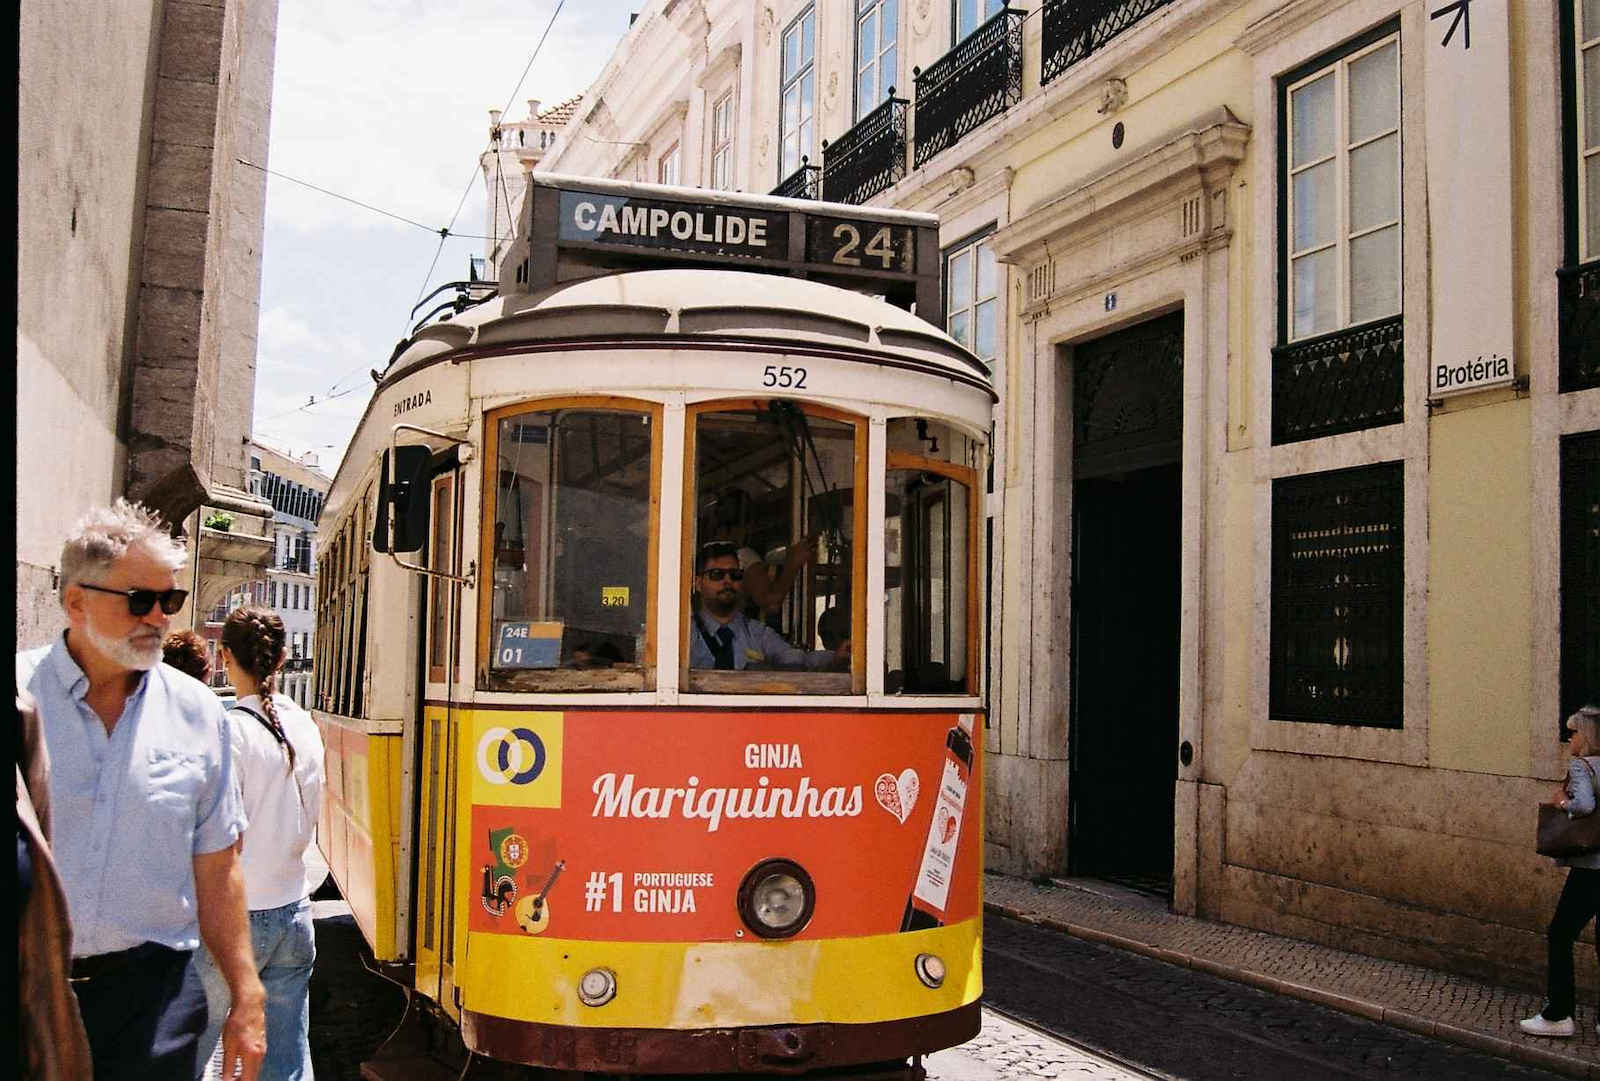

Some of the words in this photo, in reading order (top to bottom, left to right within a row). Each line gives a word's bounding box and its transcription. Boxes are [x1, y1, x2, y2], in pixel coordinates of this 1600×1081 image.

[574, 202, 767, 247] CAMPOLIDE
[832, 223, 895, 269] 24
[763, 366, 807, 389] 552
[1437, 354, 1509, 388] Brotéria
[394, 389, 432, 417] ENTRADA
[505, 627, 529, 638] 24E
[502, 648, 522, 663] 01
[745, 743, 803, 769] GINJA
[591, 772, 863, 832] Mariquinhas
[585, 872, 624, 913] #1
[633, 873, 714, 887] PORTUGUESE
[634, 889, 697, 913] GINJA
